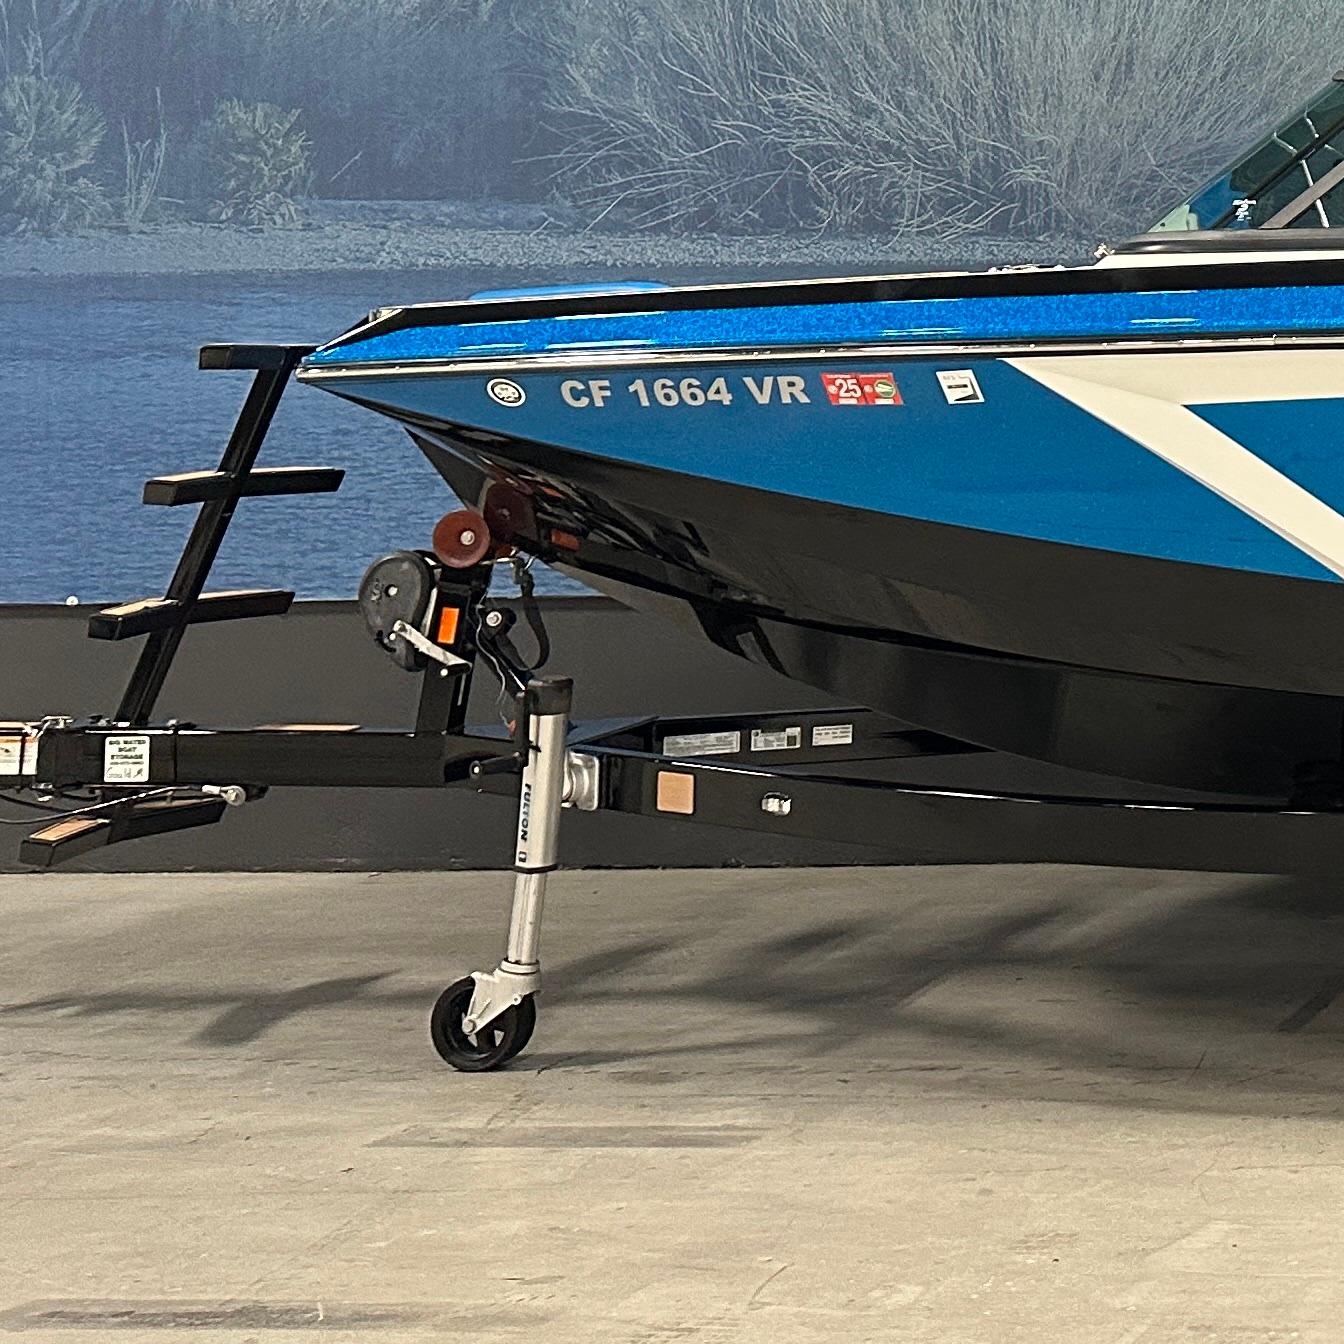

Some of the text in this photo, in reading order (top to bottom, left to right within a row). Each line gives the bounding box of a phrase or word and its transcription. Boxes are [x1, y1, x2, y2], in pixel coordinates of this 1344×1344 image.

[560, 375, 811, 408] CF 1664 VR
[835, 378, 862, 398] 25
